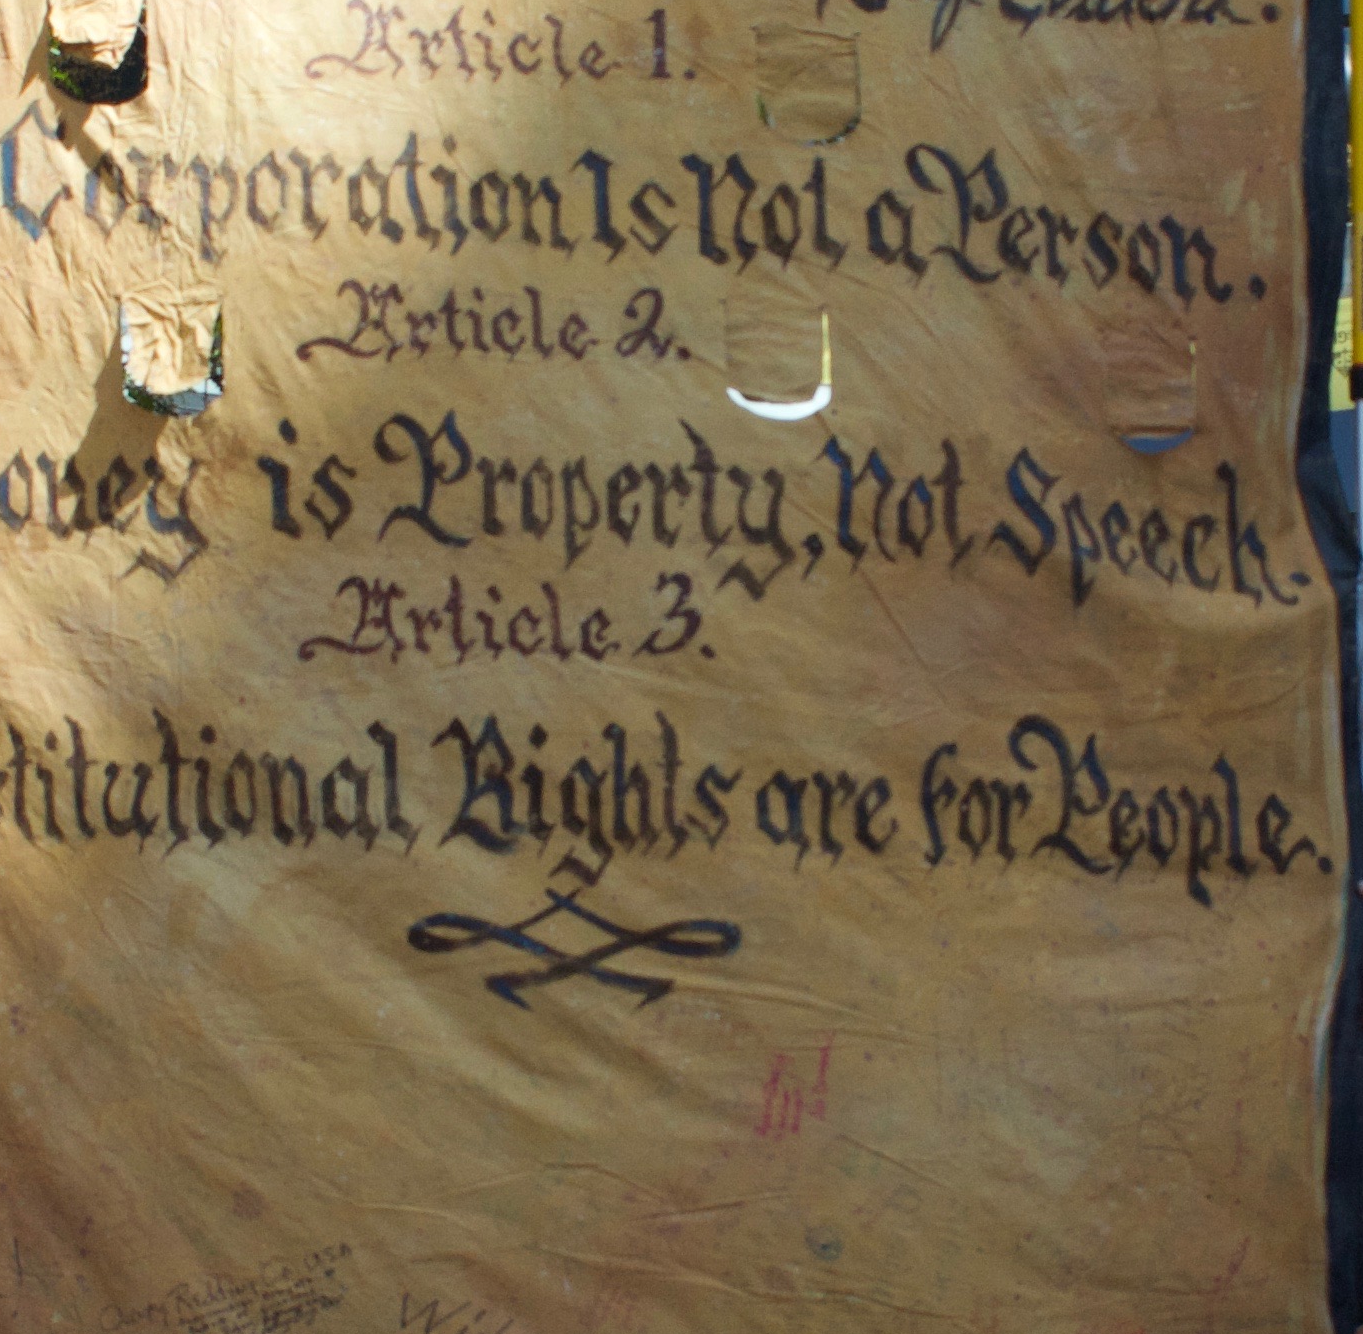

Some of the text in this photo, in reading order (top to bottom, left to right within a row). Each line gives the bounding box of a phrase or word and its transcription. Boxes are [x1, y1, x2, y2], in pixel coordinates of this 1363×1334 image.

[644, 9, 698, 80] 1.
[571, 147, 676, 263] Is
[681, 151, 848, 271] Not
[865, 180, 928, 285] a
[904, 142, 1268, 308] Person.
[296, 278, 693, 364] Article 2.
[257, 418, 357, 541] is
[373, 408, 825, 601] Property,
[823, 433, 976, 575] Not
[990, 446, 1314, 610] Speech.
[297, 572, 717, 664] Article 3.
[433, 712, 741, 888] Rights
[756, 767, 899, 864] are
[1009, 713, 1333, 910] People.
